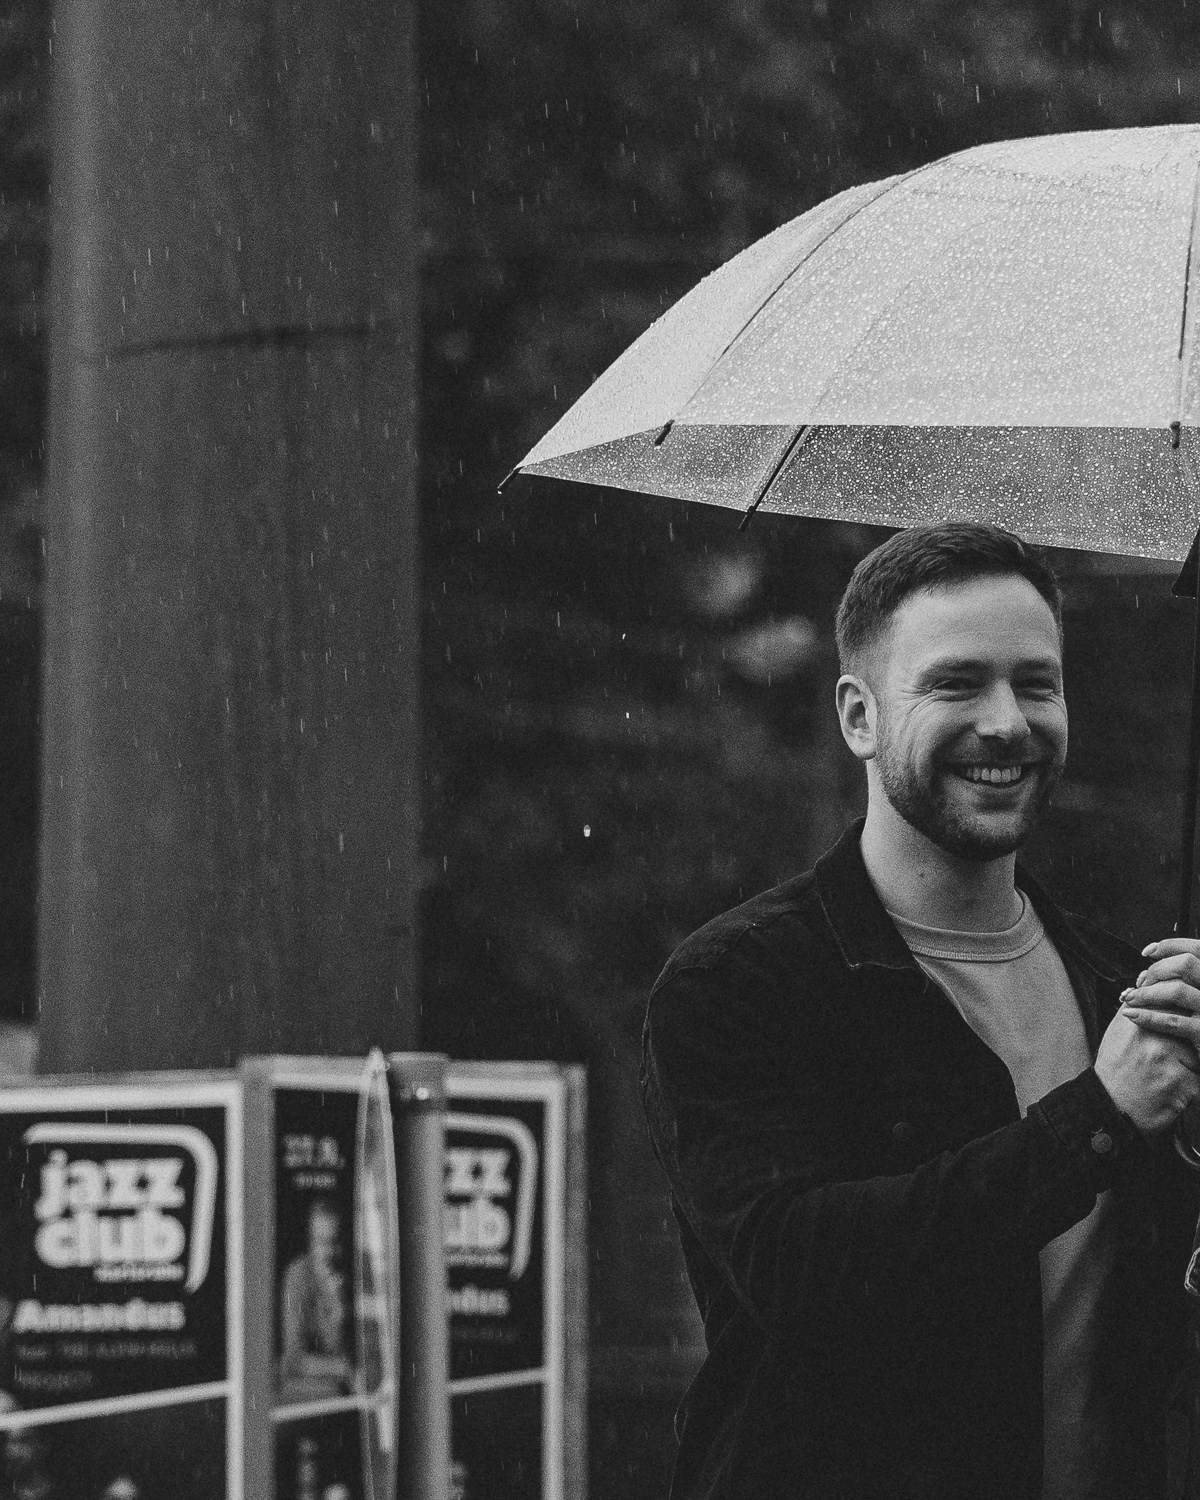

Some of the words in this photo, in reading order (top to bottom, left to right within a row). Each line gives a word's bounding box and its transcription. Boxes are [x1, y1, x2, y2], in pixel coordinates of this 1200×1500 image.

[35, 1149, 185, 1220] jazz
[445, 1147, 510, 1195] zz
[35, 1209, 186, 1268] club
[445, 1194, 511, 1248] ub
